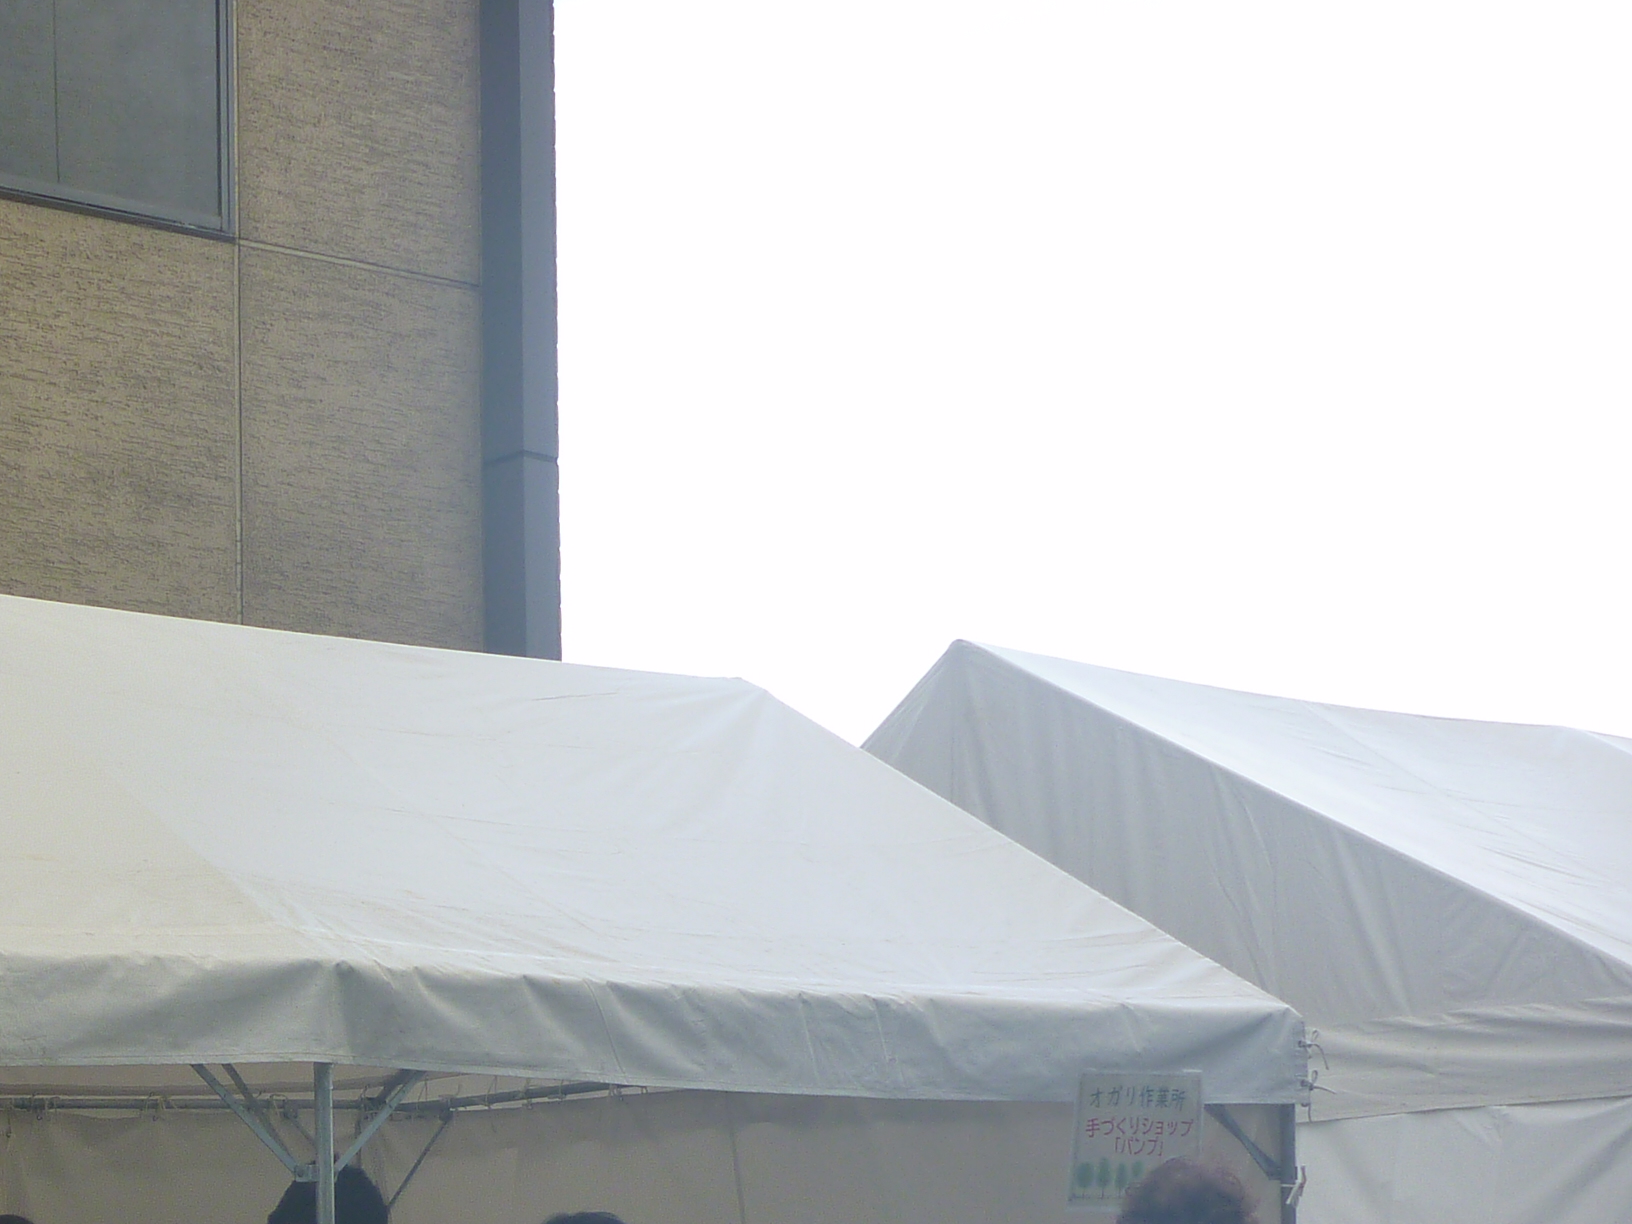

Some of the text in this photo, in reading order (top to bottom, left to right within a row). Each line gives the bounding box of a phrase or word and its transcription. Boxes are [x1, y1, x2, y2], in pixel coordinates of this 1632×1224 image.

[1090, 1085, 1186, 1111] オガリ作業所
[1085, 1117, 1194, 1138] 手づくりショップ
